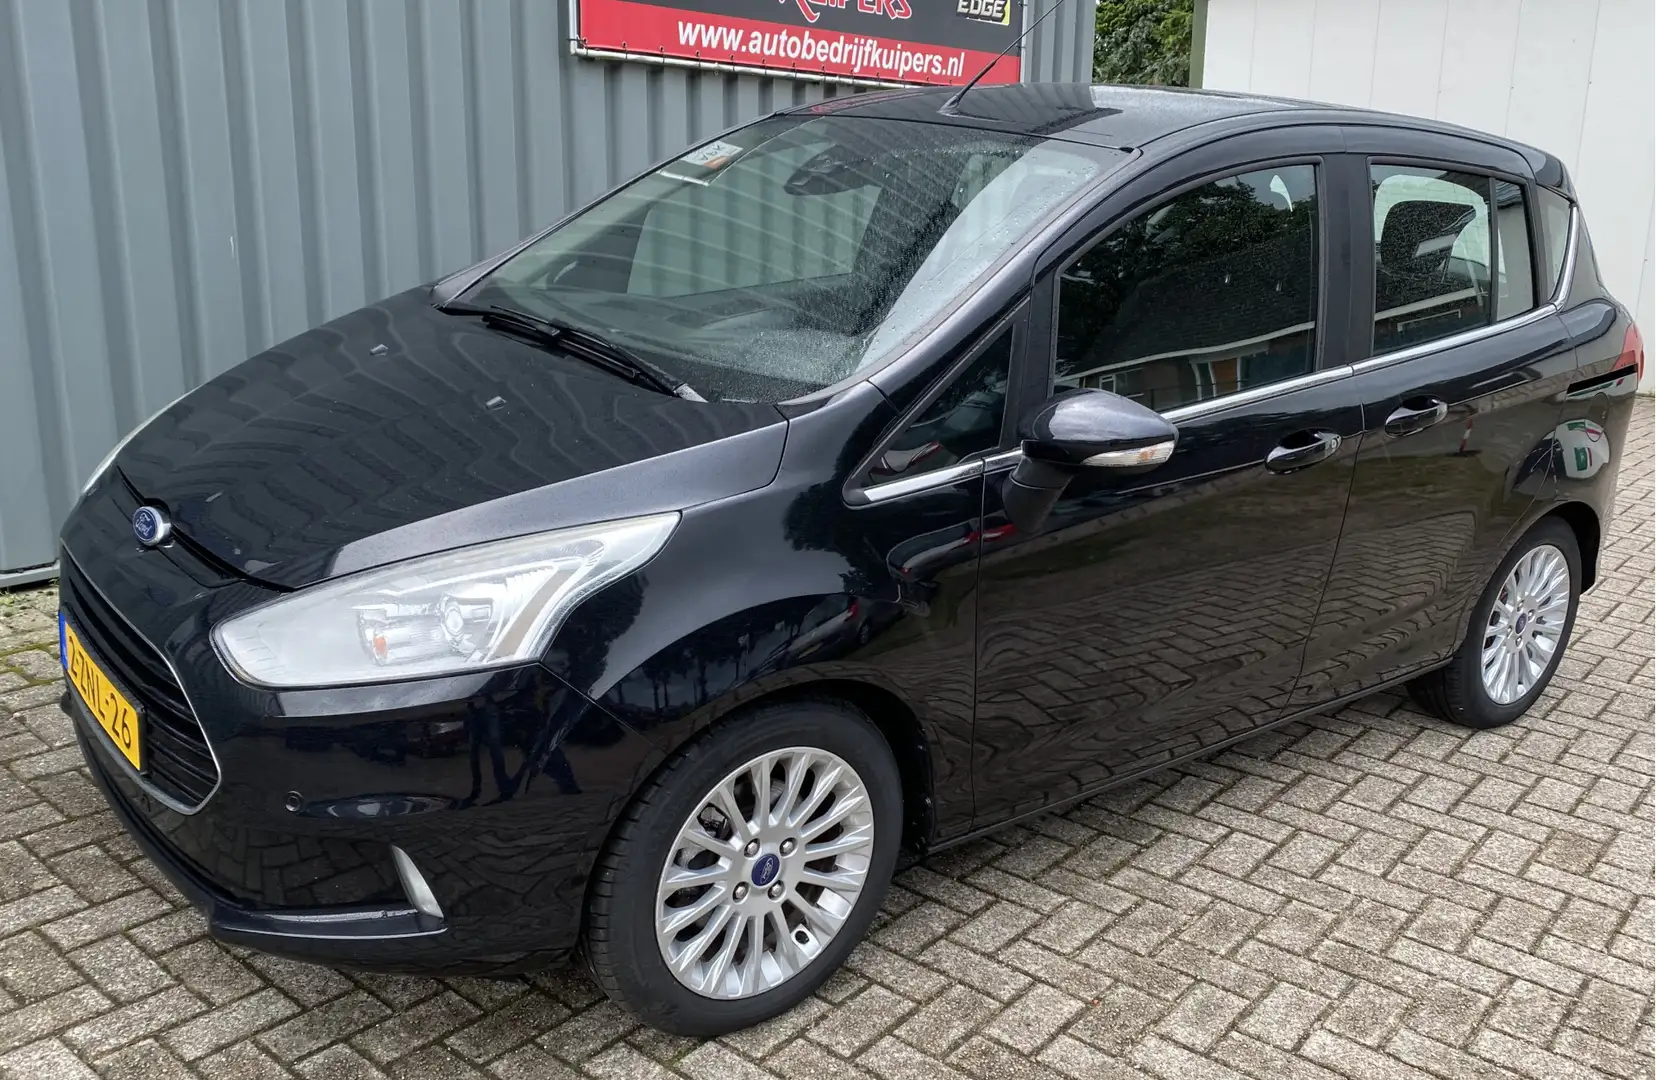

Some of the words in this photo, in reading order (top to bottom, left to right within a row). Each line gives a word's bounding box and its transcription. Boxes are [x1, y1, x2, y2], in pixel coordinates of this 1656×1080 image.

[957, 0, 1005, 18] EDGE
[677, 20, 964, 77] www.autobedrijfkuipers.nl
[68, 635, 131, 749] 2-ZNL-26
